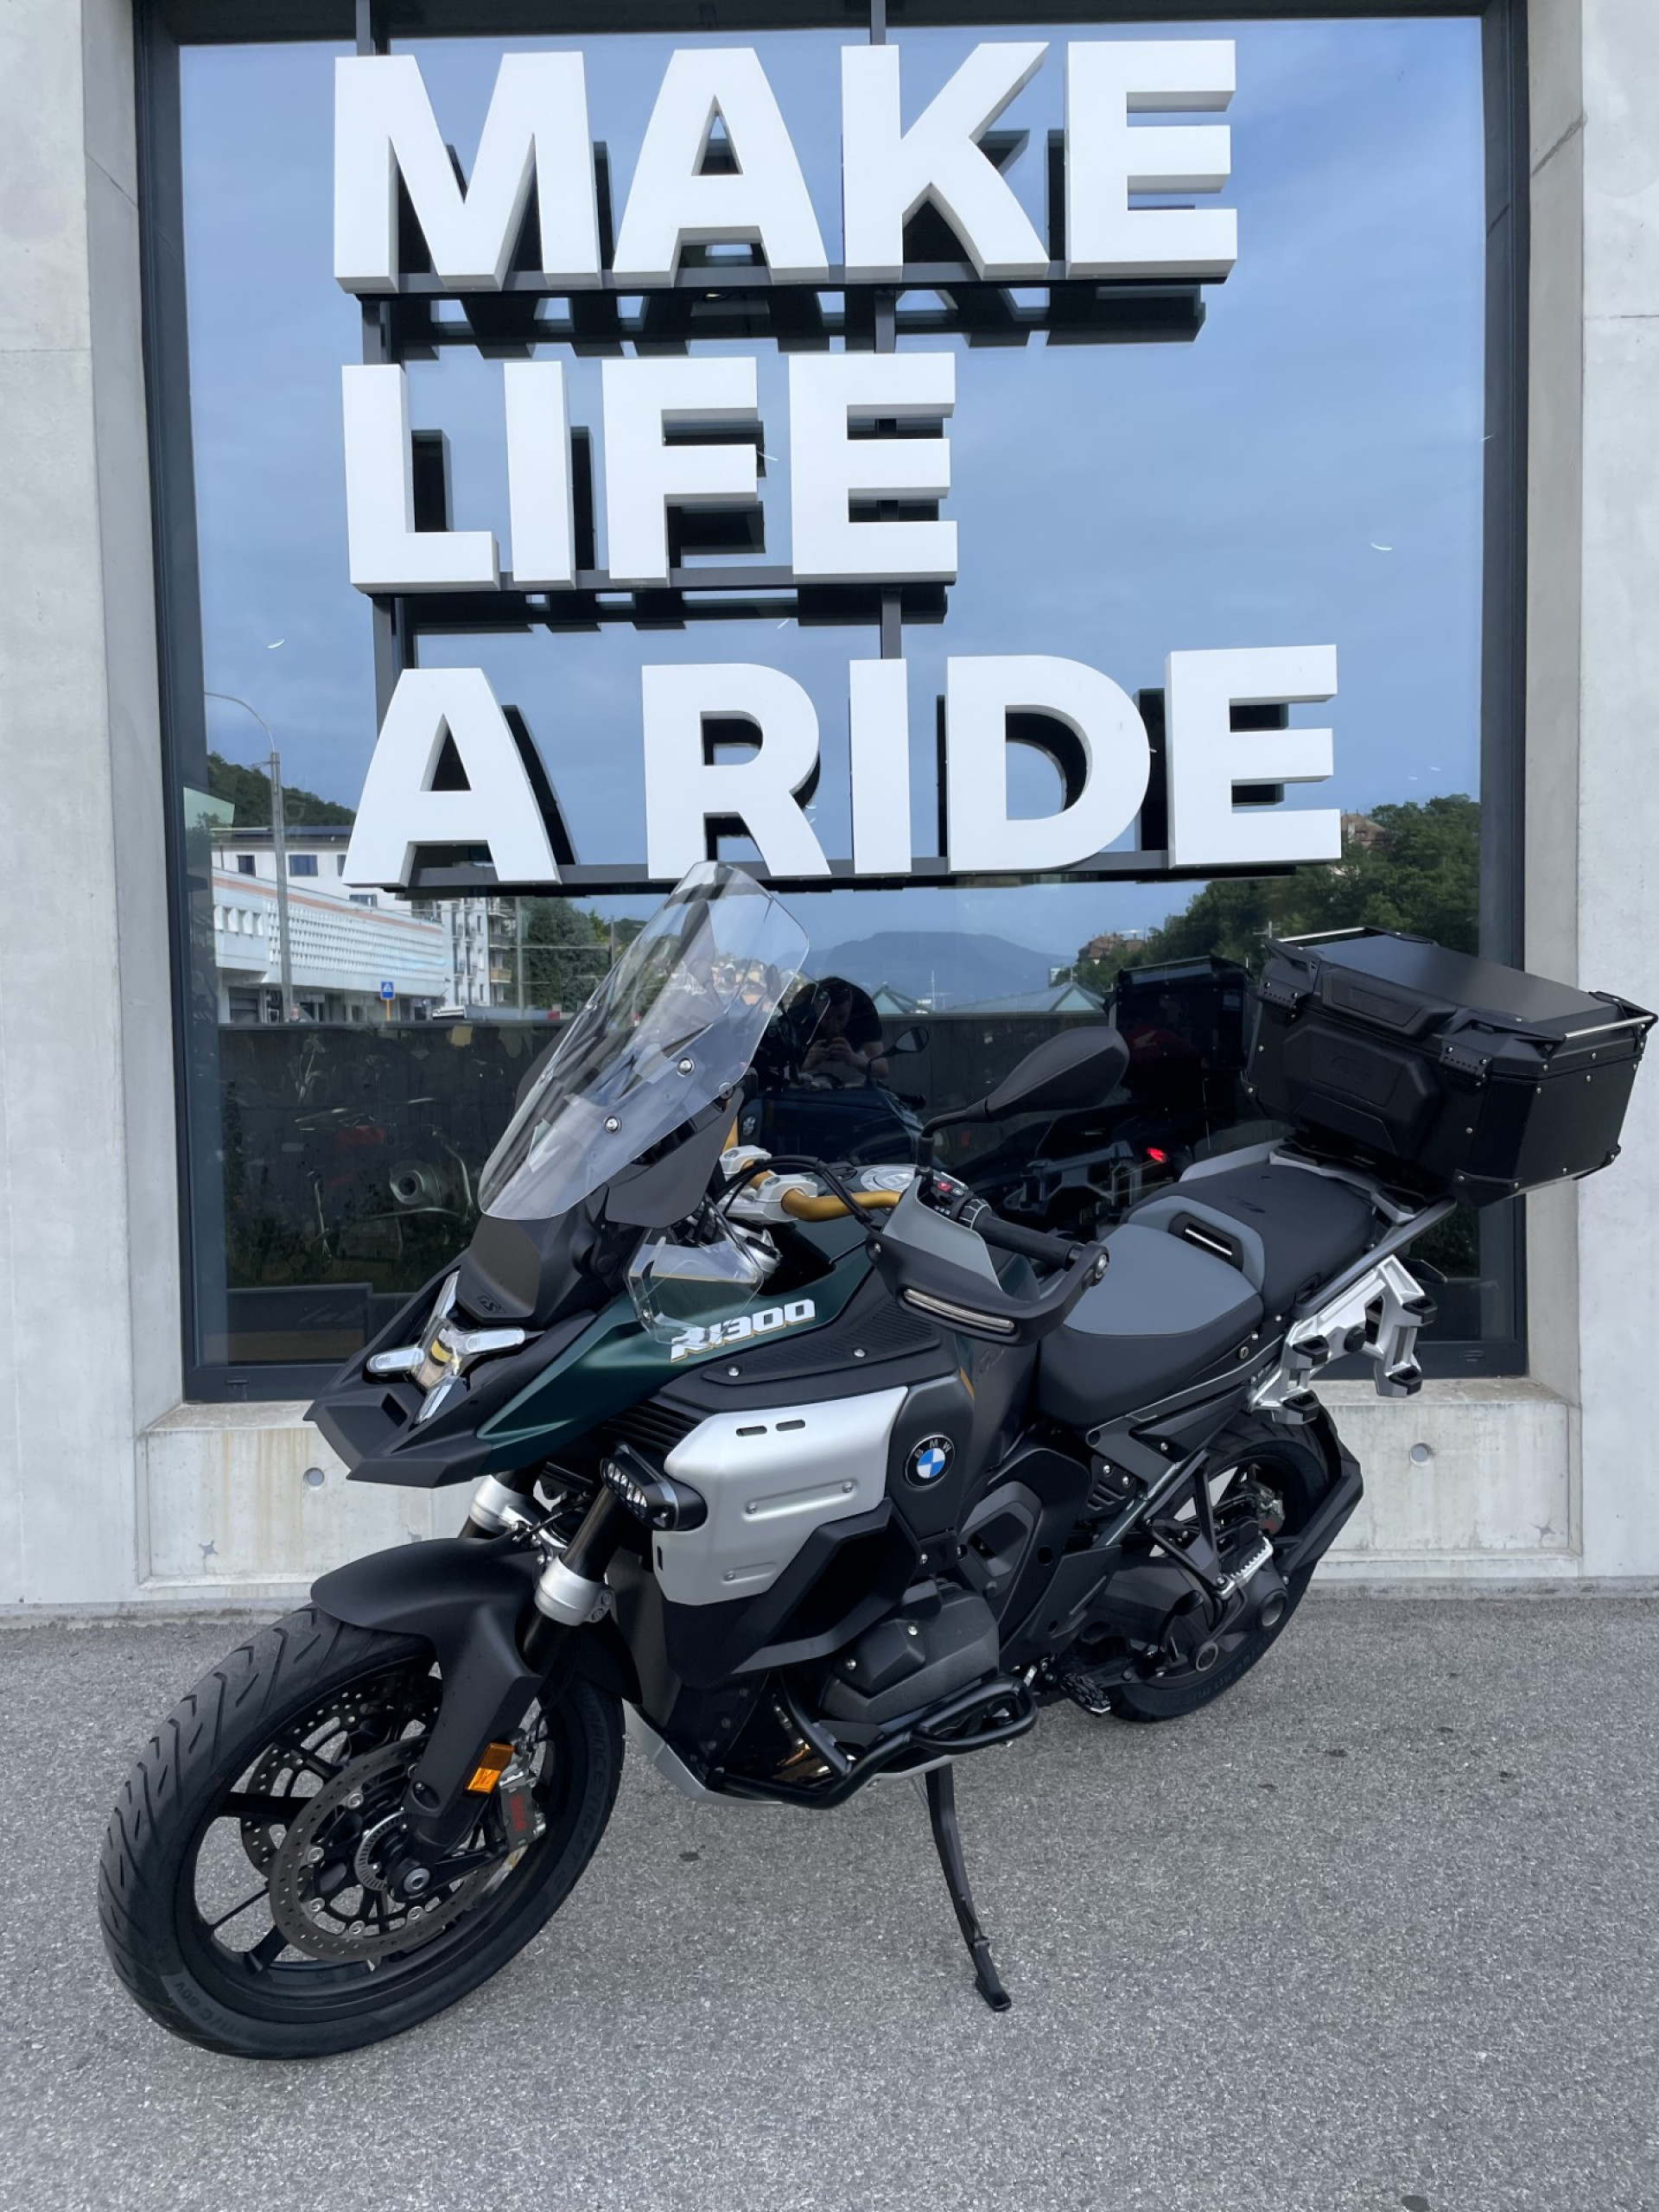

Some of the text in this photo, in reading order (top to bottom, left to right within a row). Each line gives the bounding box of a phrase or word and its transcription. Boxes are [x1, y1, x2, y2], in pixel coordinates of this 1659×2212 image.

[334, 39, 1237, 290] MAKE
[341, 353, 957, 590] LIFE
[343, 644, 1341, 886] A RIDE
[913, 1438, 952, 1459] BMW
